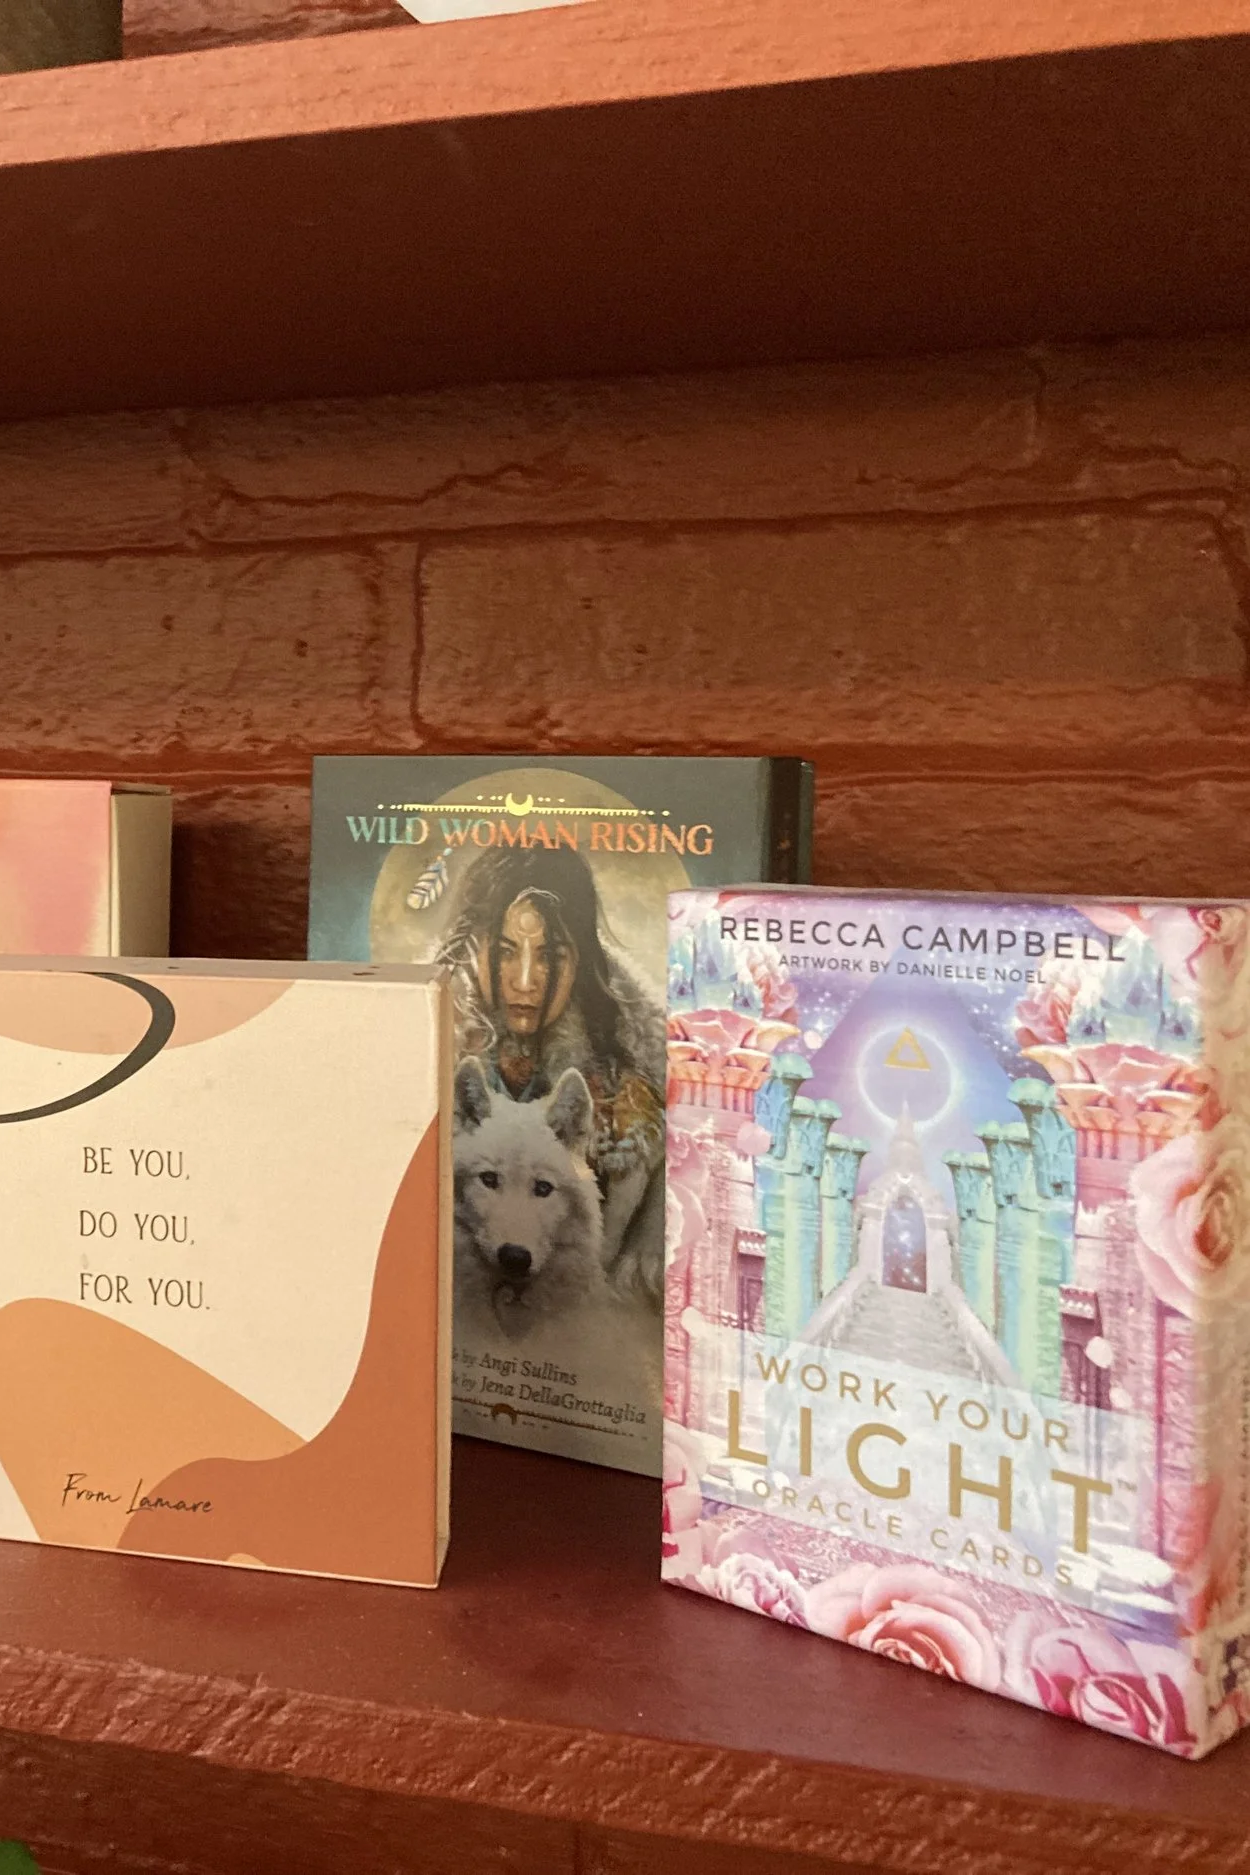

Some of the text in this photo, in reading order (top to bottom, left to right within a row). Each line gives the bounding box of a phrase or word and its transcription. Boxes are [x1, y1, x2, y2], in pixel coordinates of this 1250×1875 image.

[346, 815, 714, 856] WILD WOMAN RISING
[720, 916, 1126, 963] REBECCA CAMPBELL
[779, 954, 1046, 985] ARTWORK BY DANIELLE NOEL
[83, 1147, 190, 1180] BE YOU,
[80, 1210, 194, 1245] DO YOU,
[80, 1273, 210, 1310] FOR YOU.
[479, 1352, 518, 1376] Angi
[521, 1360, 578, 1386] Sullins
[479, 1376, 514, 1397] Jena
[519, 1383, 647, 1425] DellaGrottaglia
[755, 1352, 1069, 1453] WORK YOUR
[61, 1472, 214, 1515] From Lamare
[753, 1478, 1073, 1588] ORACLE CARDS
